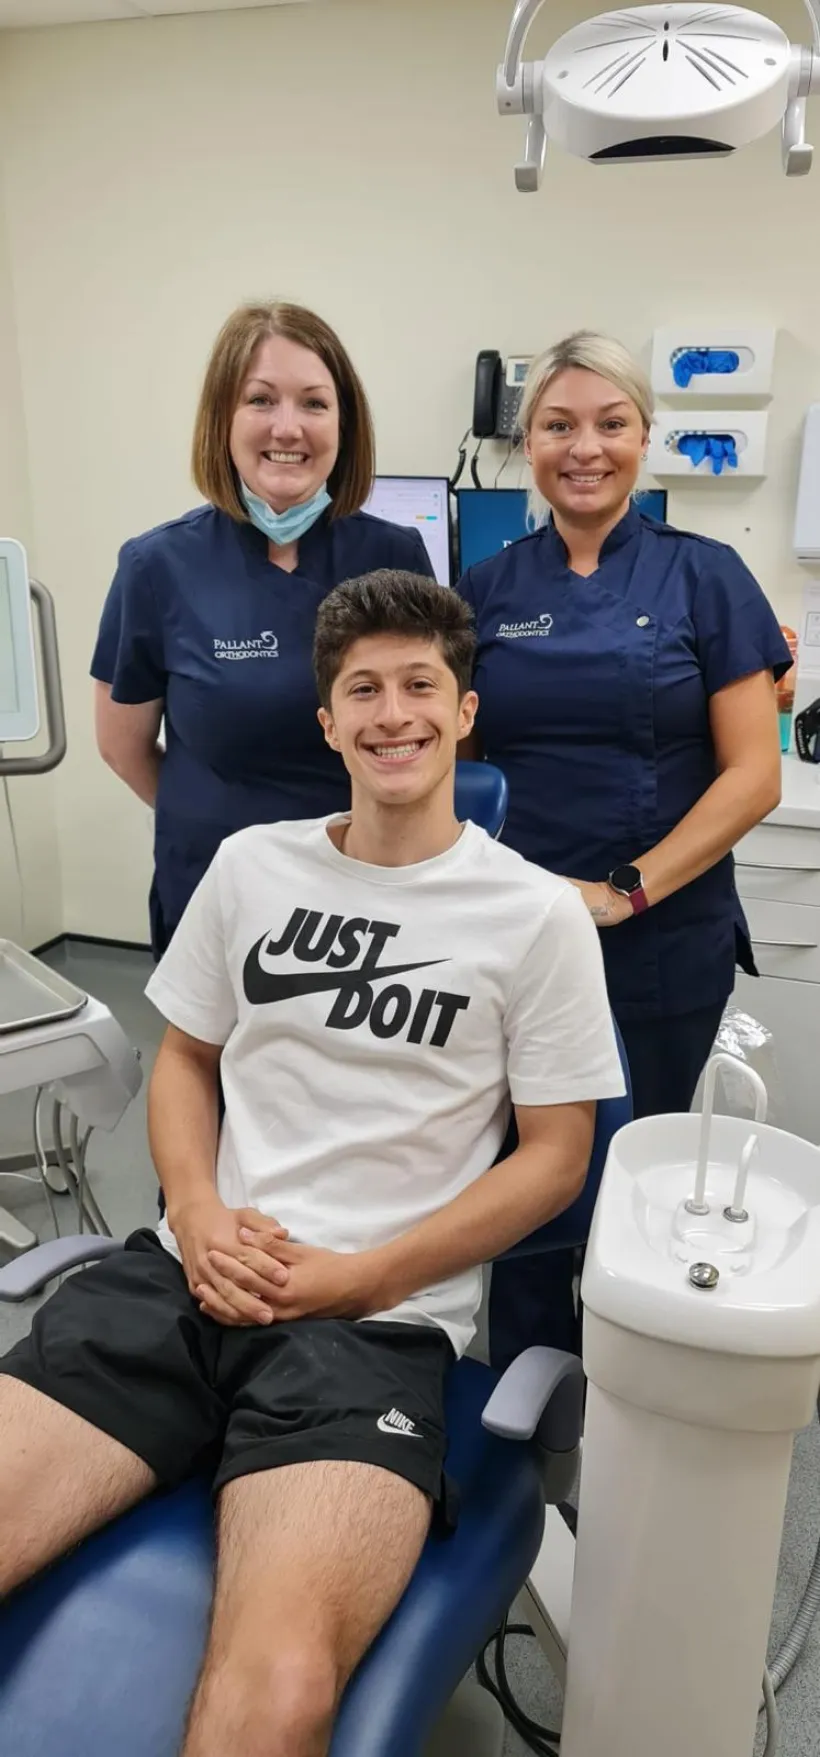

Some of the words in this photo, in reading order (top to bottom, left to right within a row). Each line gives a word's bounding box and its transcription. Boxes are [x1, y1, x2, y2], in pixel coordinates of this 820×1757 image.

[499, 621, 539, 632] PALLANT
[213, 639, 263, 650] PALLANT
[266, 907, 401, 971] JUST
[385, 1407, 415, 1431] NIKE
